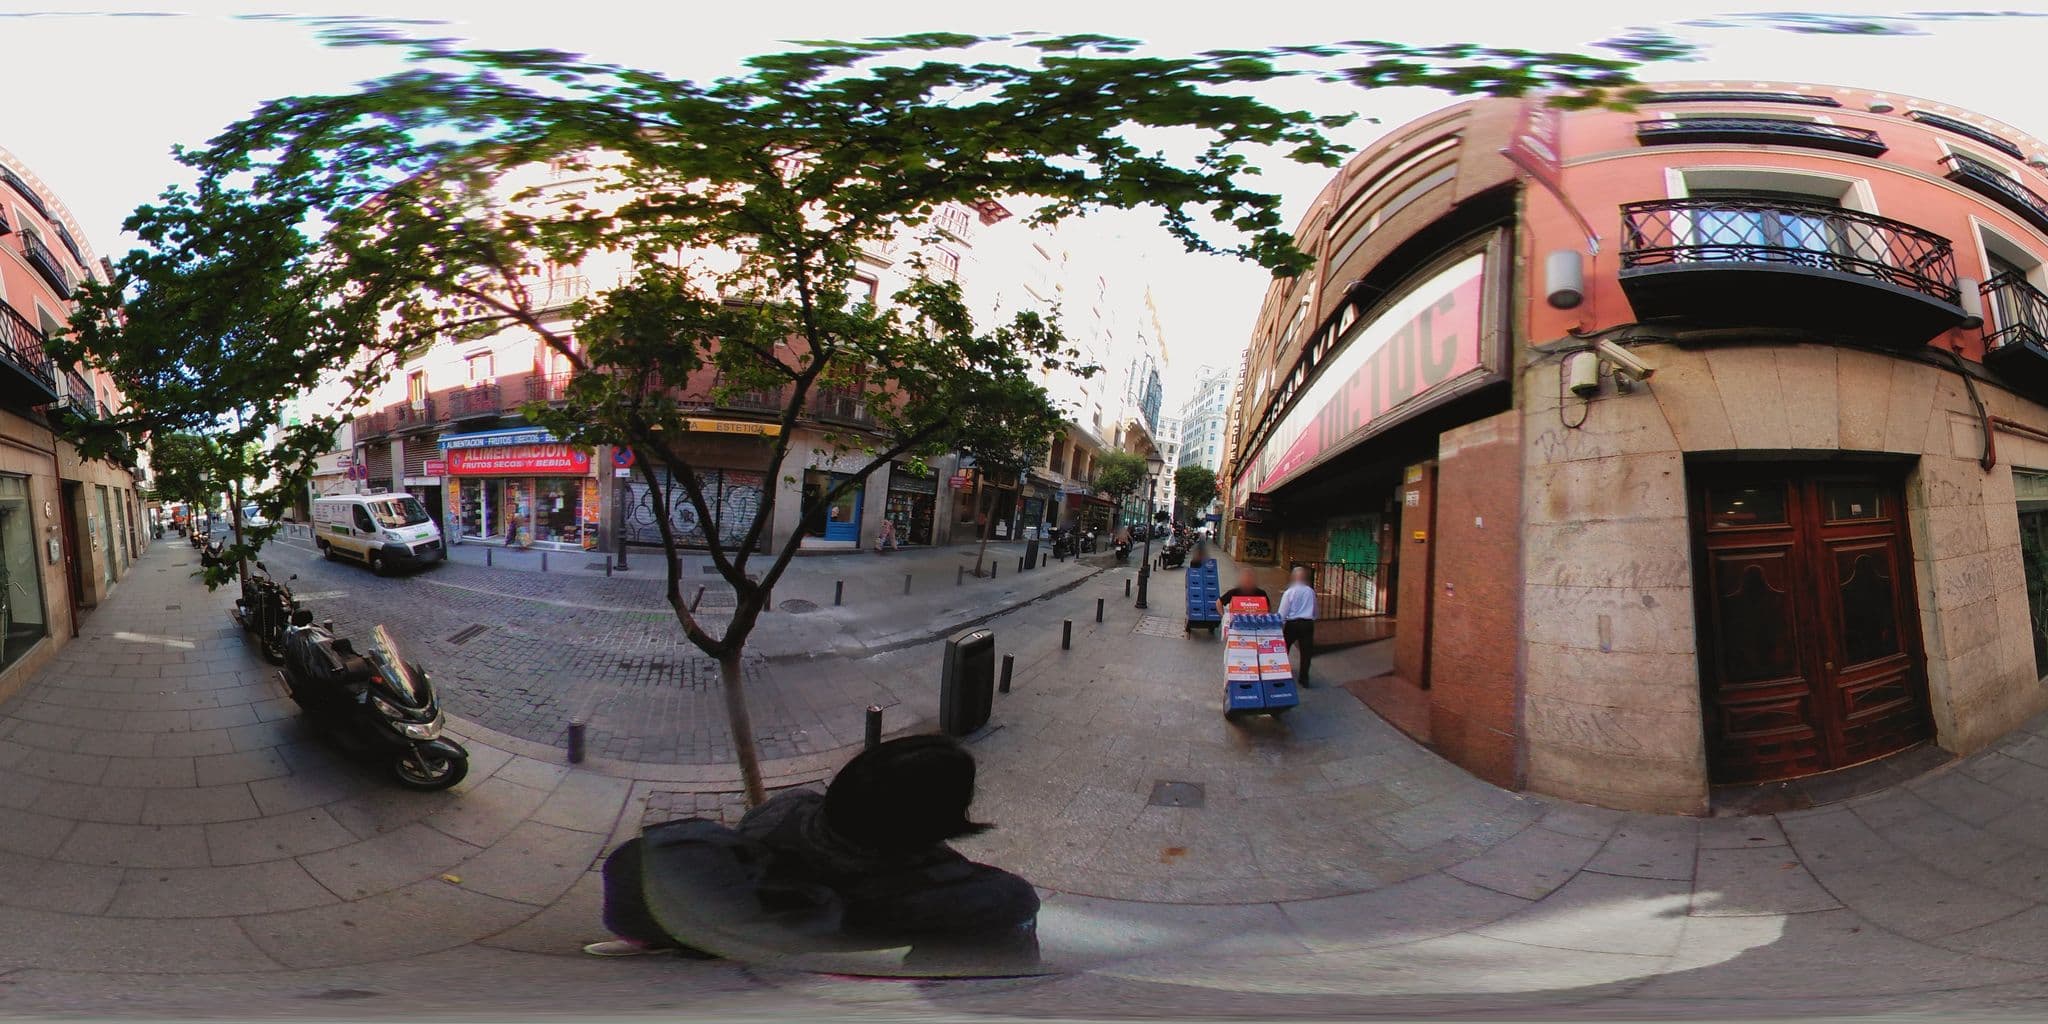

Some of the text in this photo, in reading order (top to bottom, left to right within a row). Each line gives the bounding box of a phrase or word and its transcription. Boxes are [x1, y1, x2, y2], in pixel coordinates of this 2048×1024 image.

[1271, 359, 1307, 424] GRAN
[1313, 303, 1360, 366] VIA
[717, 422, 764, 433] ESTETICA
[462, 459, 571, 469] FRUTOS SECOS Y BEBIDA
